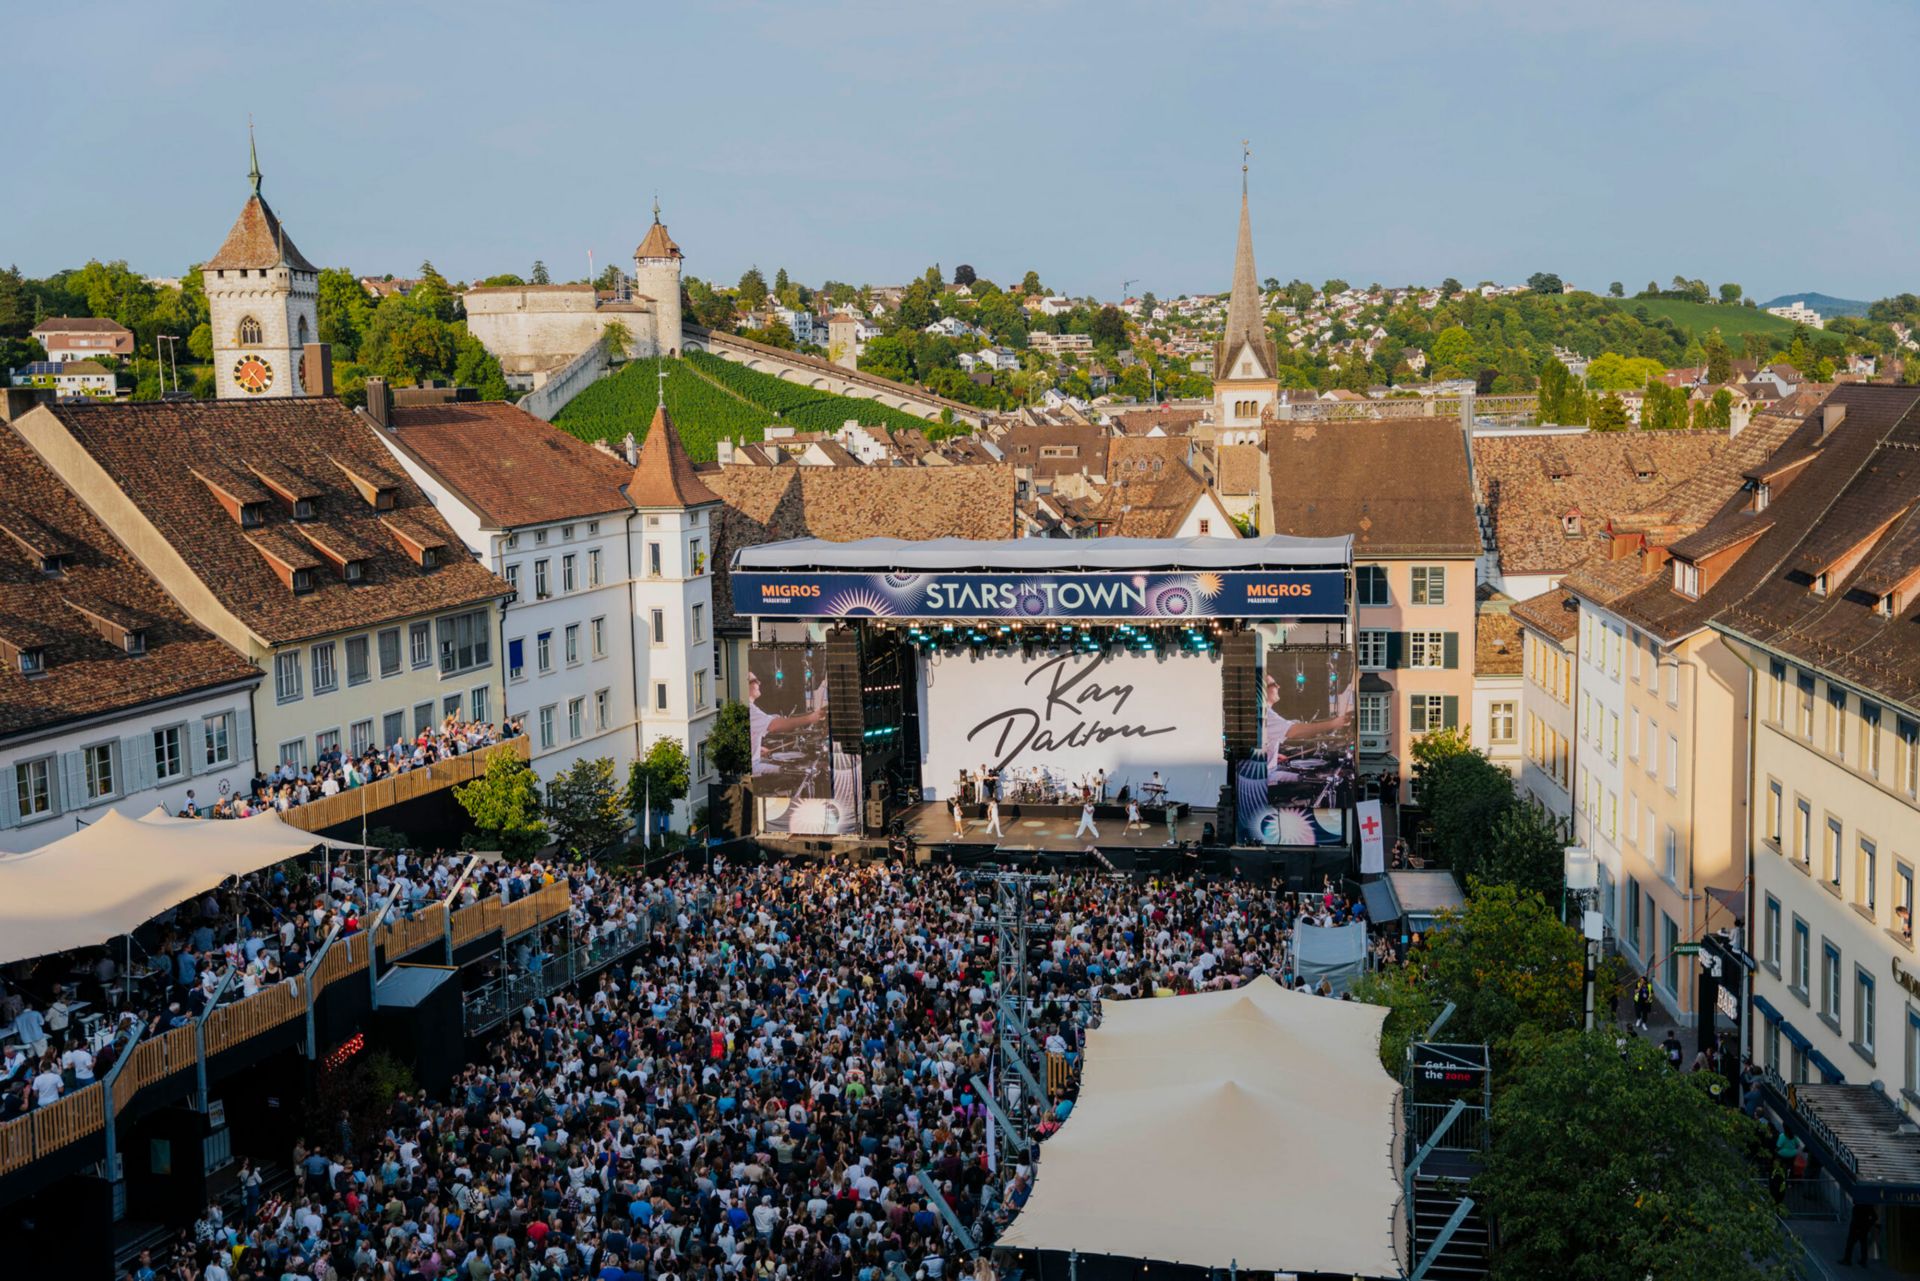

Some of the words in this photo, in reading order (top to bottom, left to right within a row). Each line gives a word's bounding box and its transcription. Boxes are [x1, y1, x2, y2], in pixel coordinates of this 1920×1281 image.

[761, 585, 821, 597] MIGROS
[926, 583, 1018, 609] STARS
[1020, 584, 1037, 596] IN
[1040, 583, 1146, 609] TOWN
[1247, 584, 1312, 596] MIGROS
[1025, 650, 1134, 721] Ray
[967, 708, 1176, 772] Dalton
[1425, 1061, 1443, 1070] Get
[1425, 1070, 1443, 1079] the
[1445, 1072, 1472, 1080] zone
